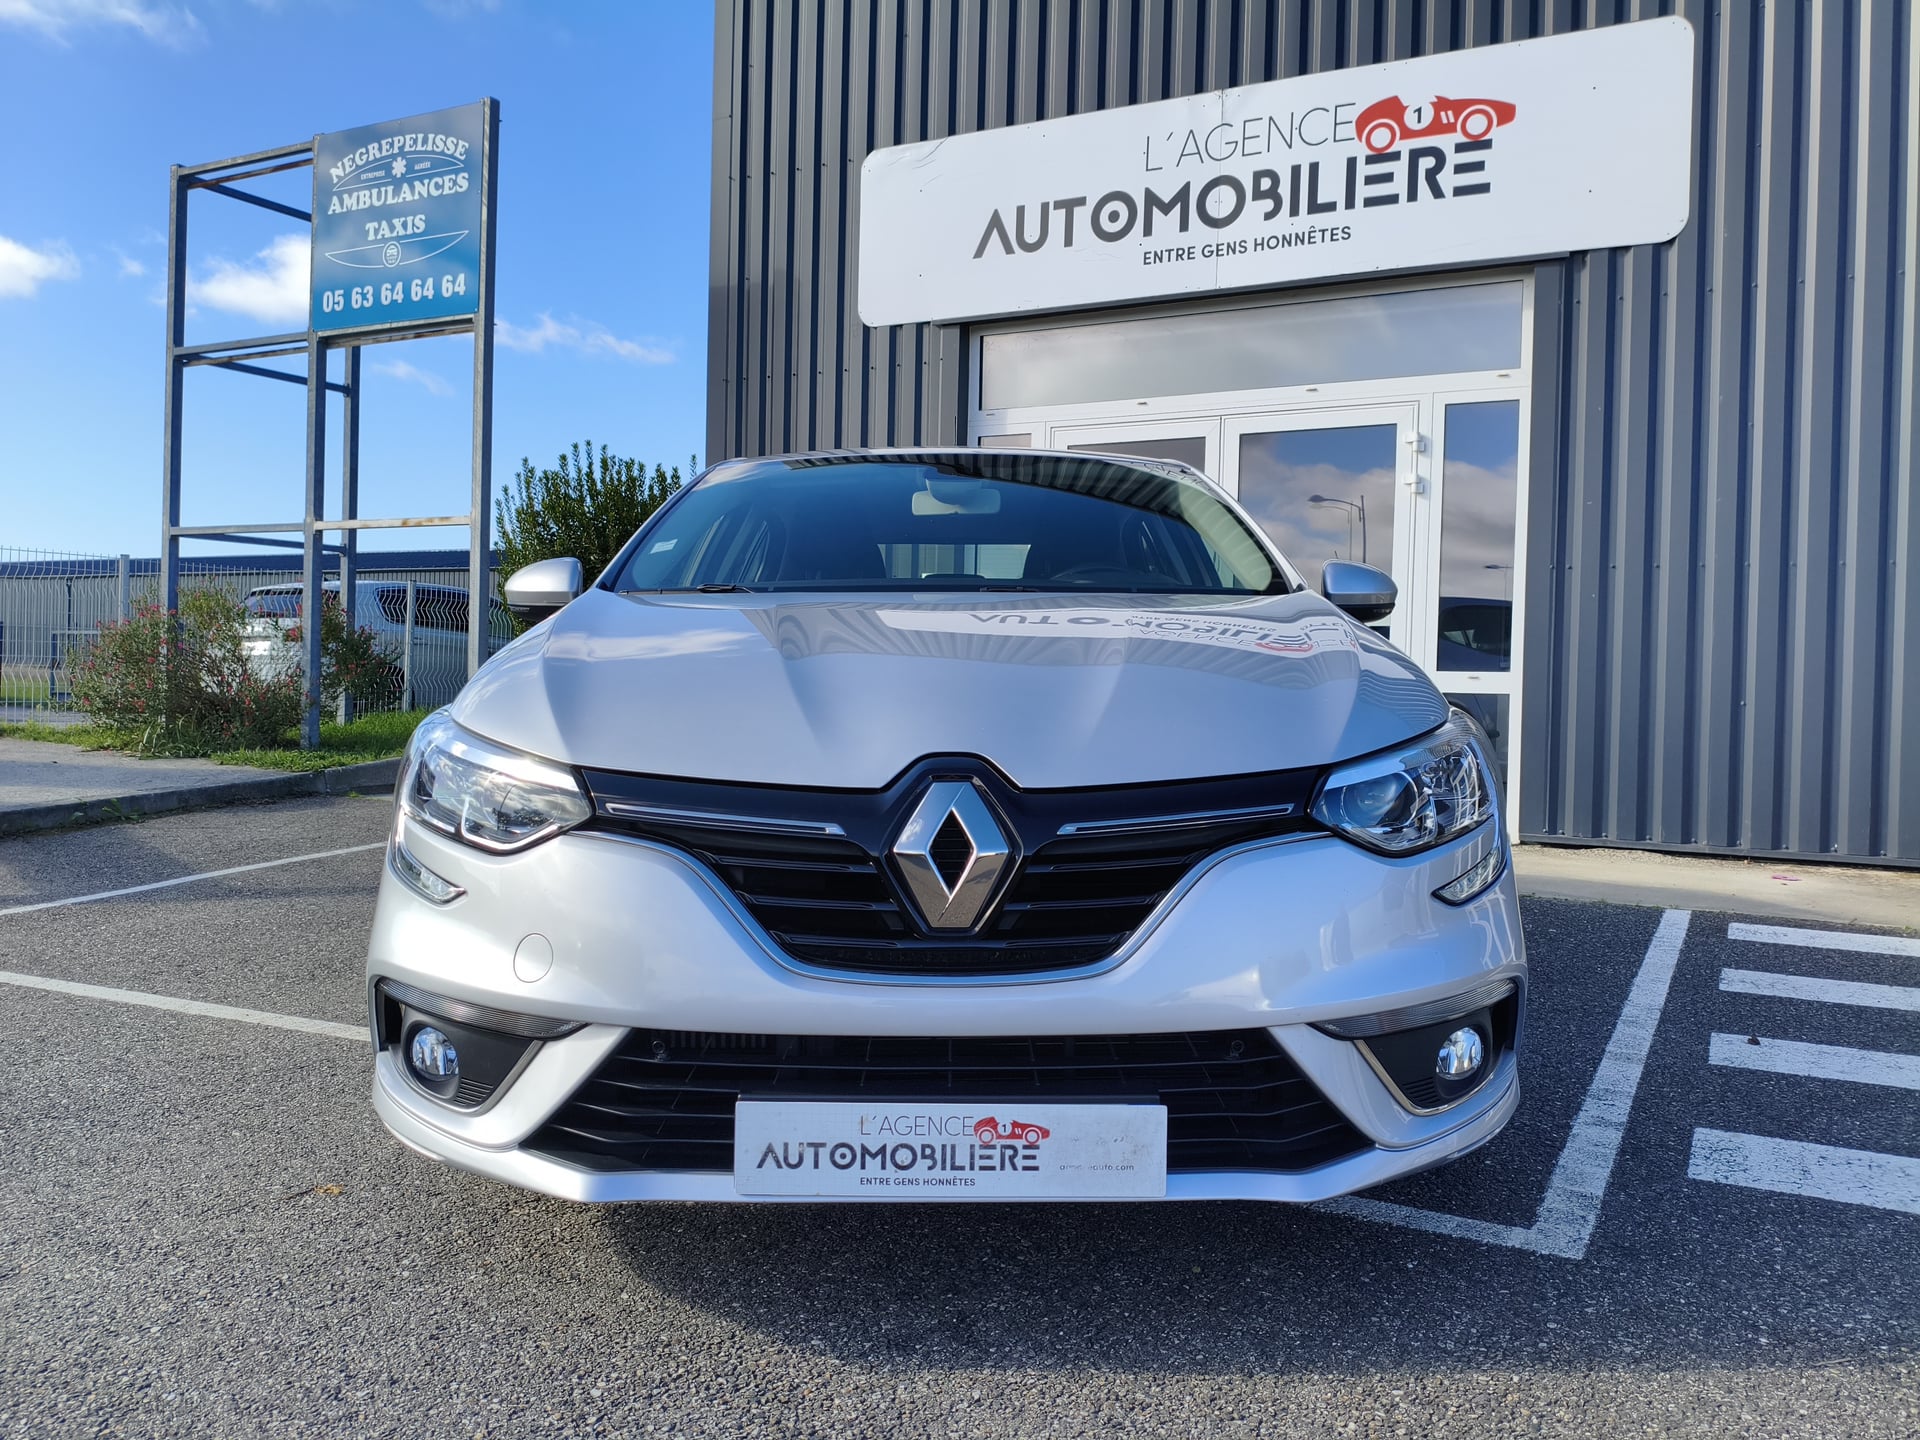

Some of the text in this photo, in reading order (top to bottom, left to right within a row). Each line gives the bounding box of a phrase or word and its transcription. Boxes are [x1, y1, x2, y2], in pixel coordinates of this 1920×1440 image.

[1145, 102, 1357, 172] L'AGENCE
[329, 133, 469, 184] NEGREPELISSE
[328, 172, 469, 215] AMBULANCES
[972, 138, 1493, 259] AUTOMOBILIERE
[365, 214, 426, 241] TAXIS
[1142, 225, 1352, 266] ENTRE GENS HONNÊTES
[323, 273, 466, 313] 05 63 64 64 64
[859, 1115, 975, 1137] L'AGENCE
[756, 1142, 1040, 1172] AUTOMOBILIERE
[859, 1174, 976, 1186] ENTRE GENS HONNÊTES
